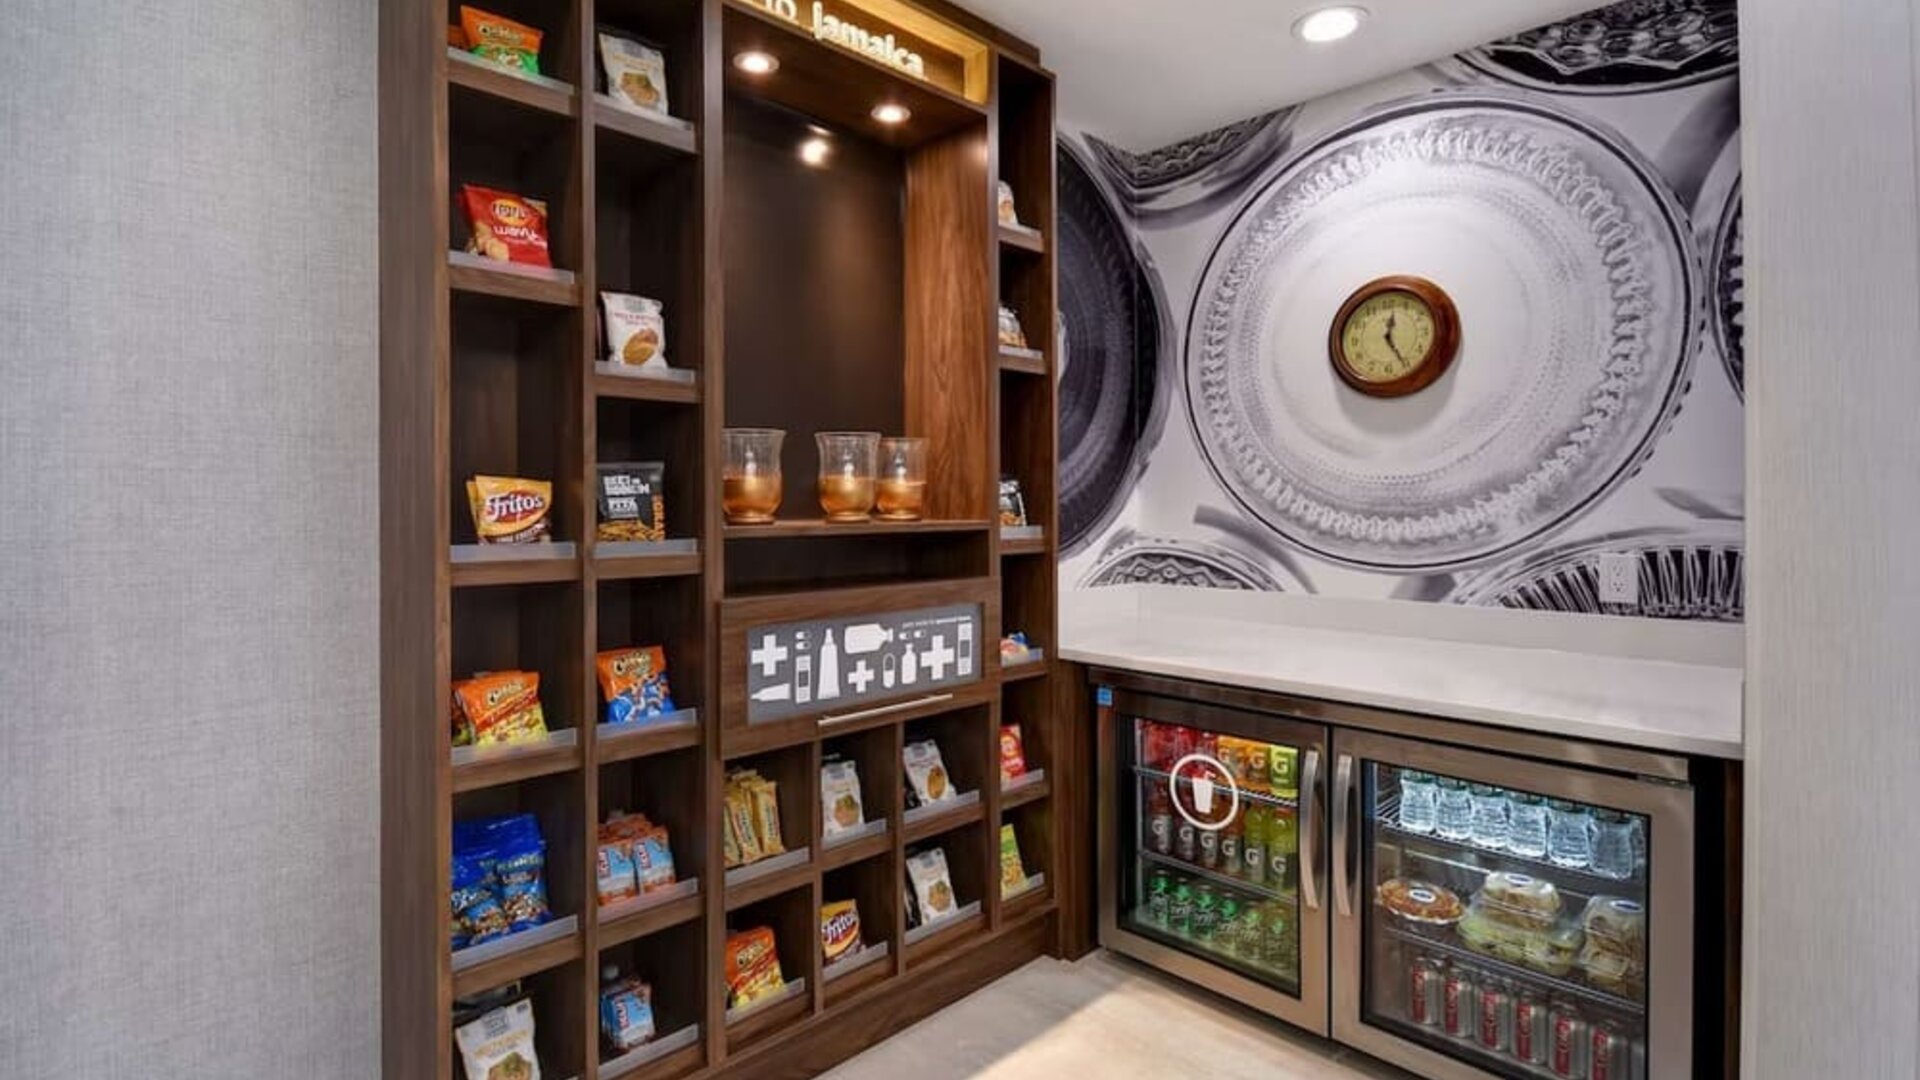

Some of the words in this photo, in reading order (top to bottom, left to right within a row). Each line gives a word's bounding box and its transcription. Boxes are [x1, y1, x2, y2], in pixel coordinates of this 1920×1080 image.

[485, 493, 545, 522] Fritos
[1272, 757, 1289, 774] G
[1180, 825, 1194, 841] G
[1201, 832, 1216, 848] G
[1222, 839, 1236, 856] G
[1245, 848, 1260, 865] G
[1272, 856, 1287, 874] G
